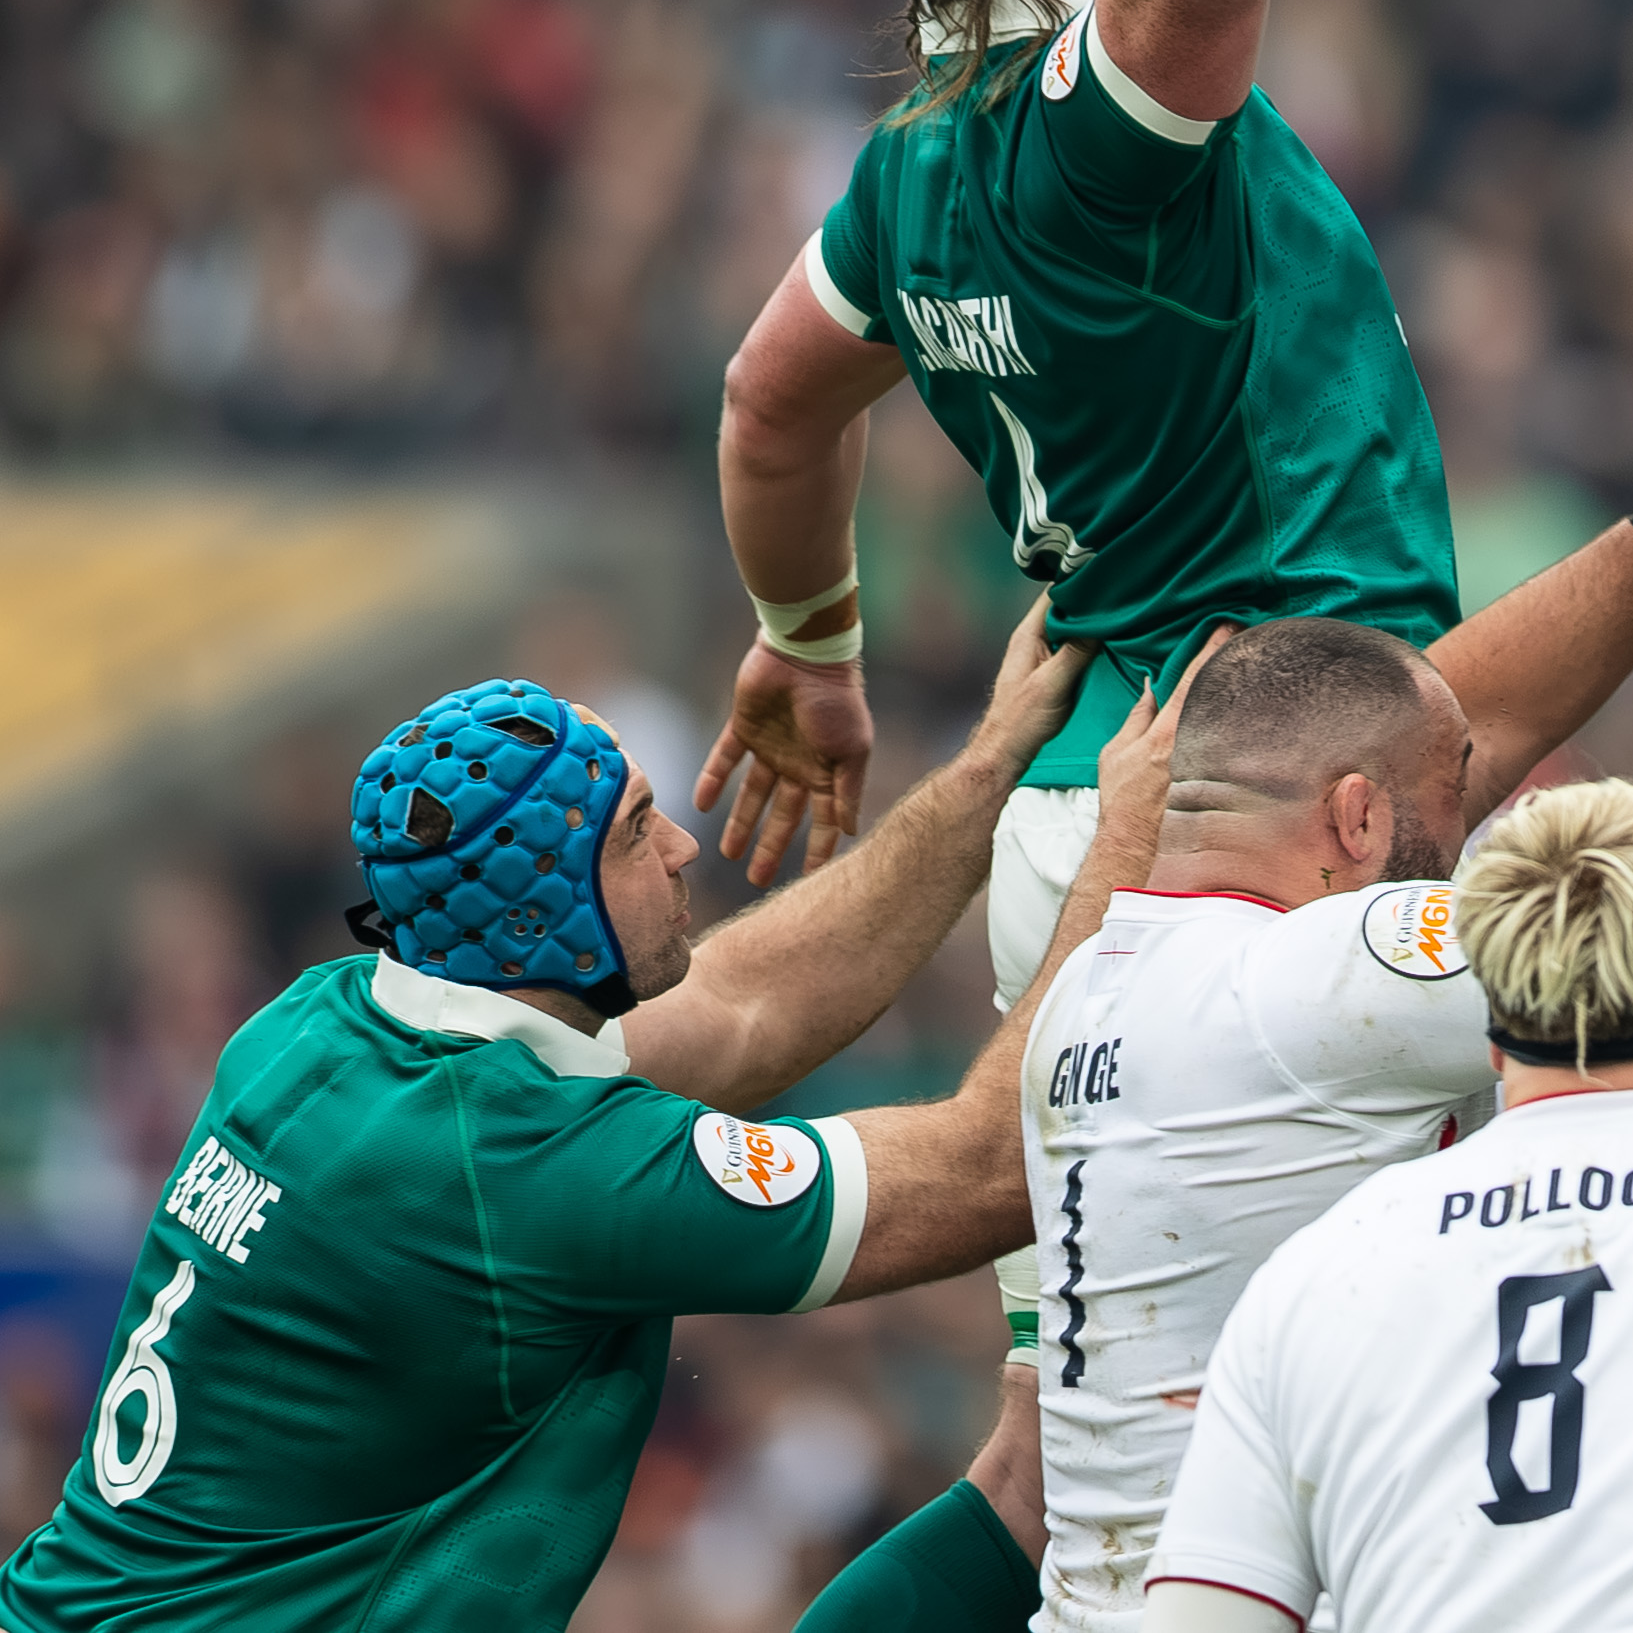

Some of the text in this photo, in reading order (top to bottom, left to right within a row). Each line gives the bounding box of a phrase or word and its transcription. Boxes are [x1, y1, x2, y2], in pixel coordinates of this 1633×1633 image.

[164, 1135, 283, 1265] BEIRNE
[93, 1259, 196, 1508] 6
[1477, 1263, 1614, 1526] 8
